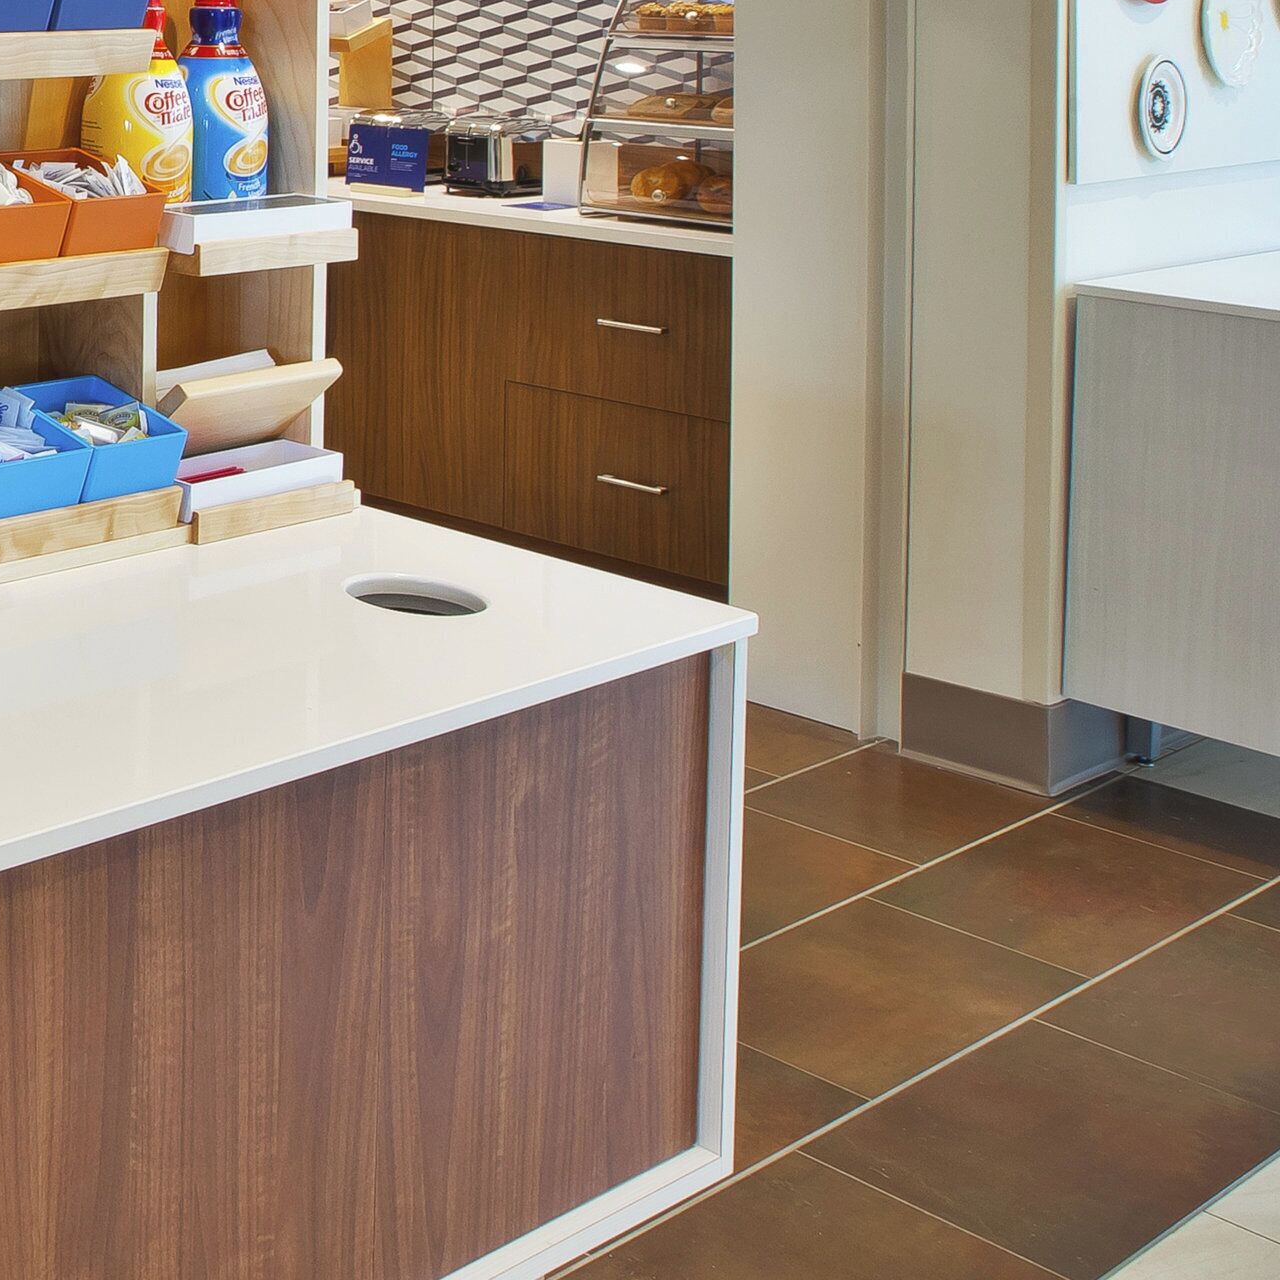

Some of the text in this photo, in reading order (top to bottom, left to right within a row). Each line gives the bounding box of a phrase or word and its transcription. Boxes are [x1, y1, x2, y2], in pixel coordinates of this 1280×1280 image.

[144, 90, 187, 114] Coffee
[225, 87, 263, 112] Coffee
[348, 156, 374, 165] SERVICE
[348, 164, 378, 173] AVAILABLE
